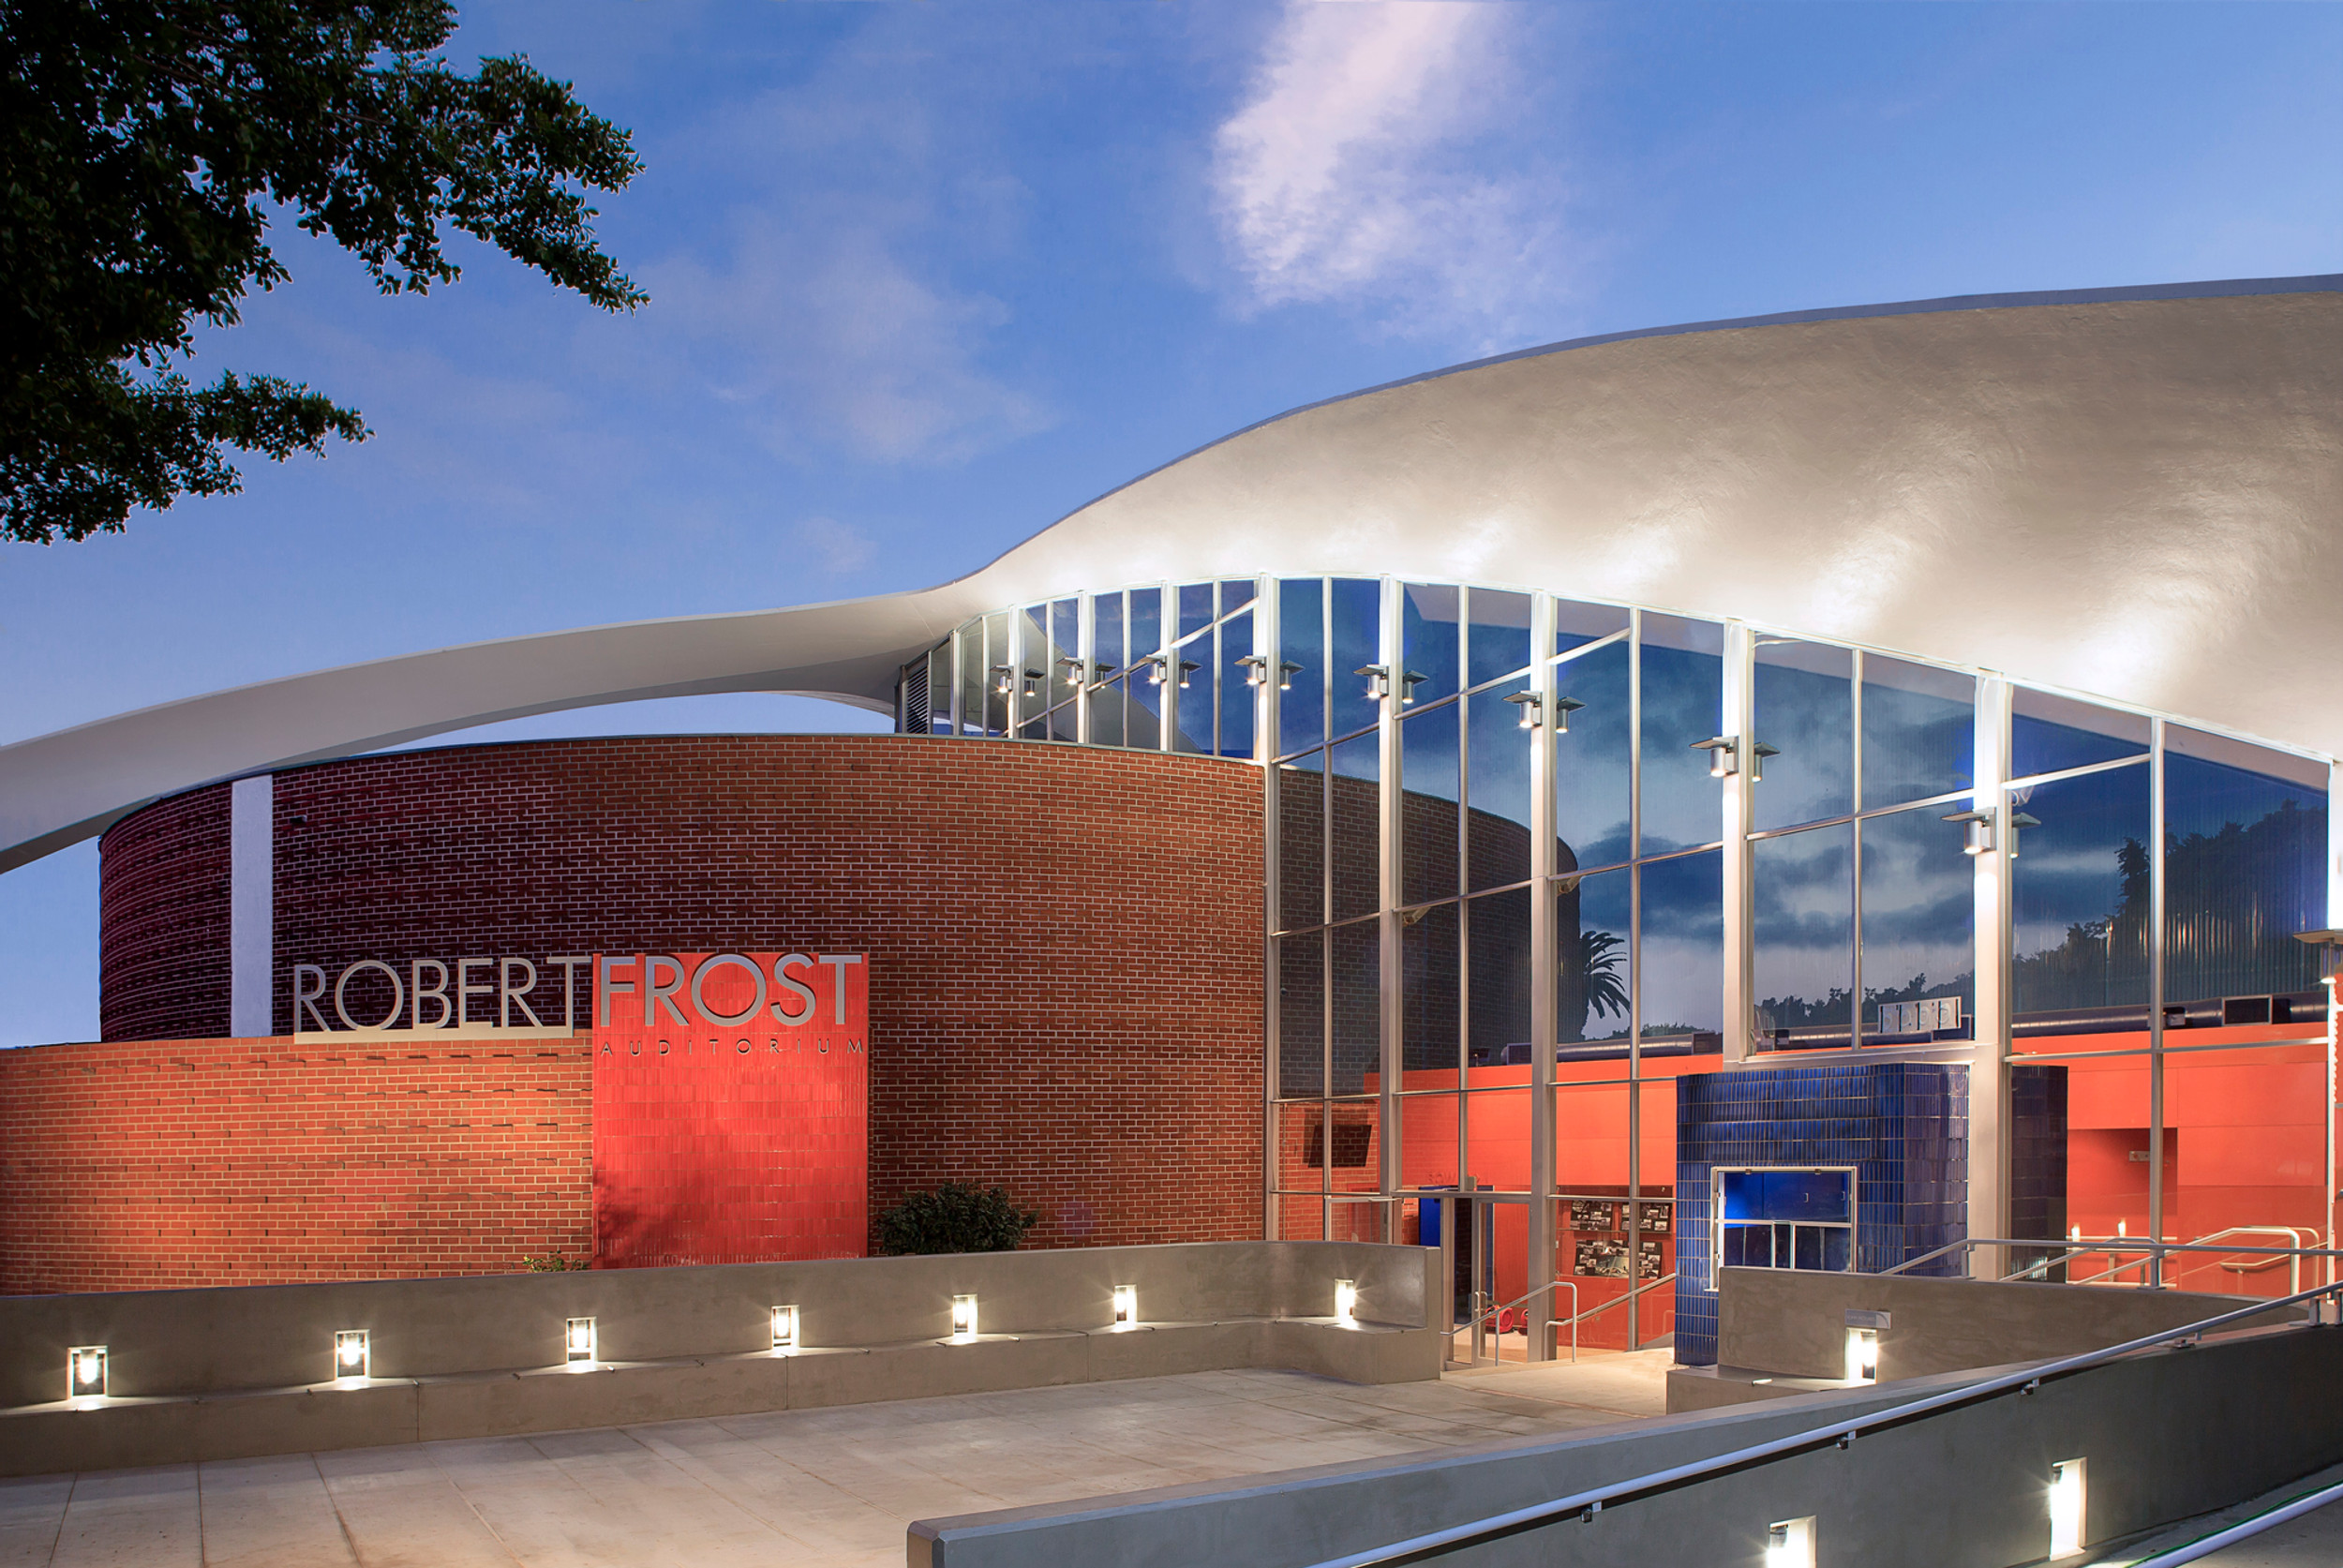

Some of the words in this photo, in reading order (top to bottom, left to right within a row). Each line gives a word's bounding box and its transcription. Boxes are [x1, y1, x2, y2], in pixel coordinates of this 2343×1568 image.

[293, 956, 592, 1040] ROBERT
[600, 953, 862, 1026] FROST
[601, 1038, 863, 1057] AUDITORIUM
